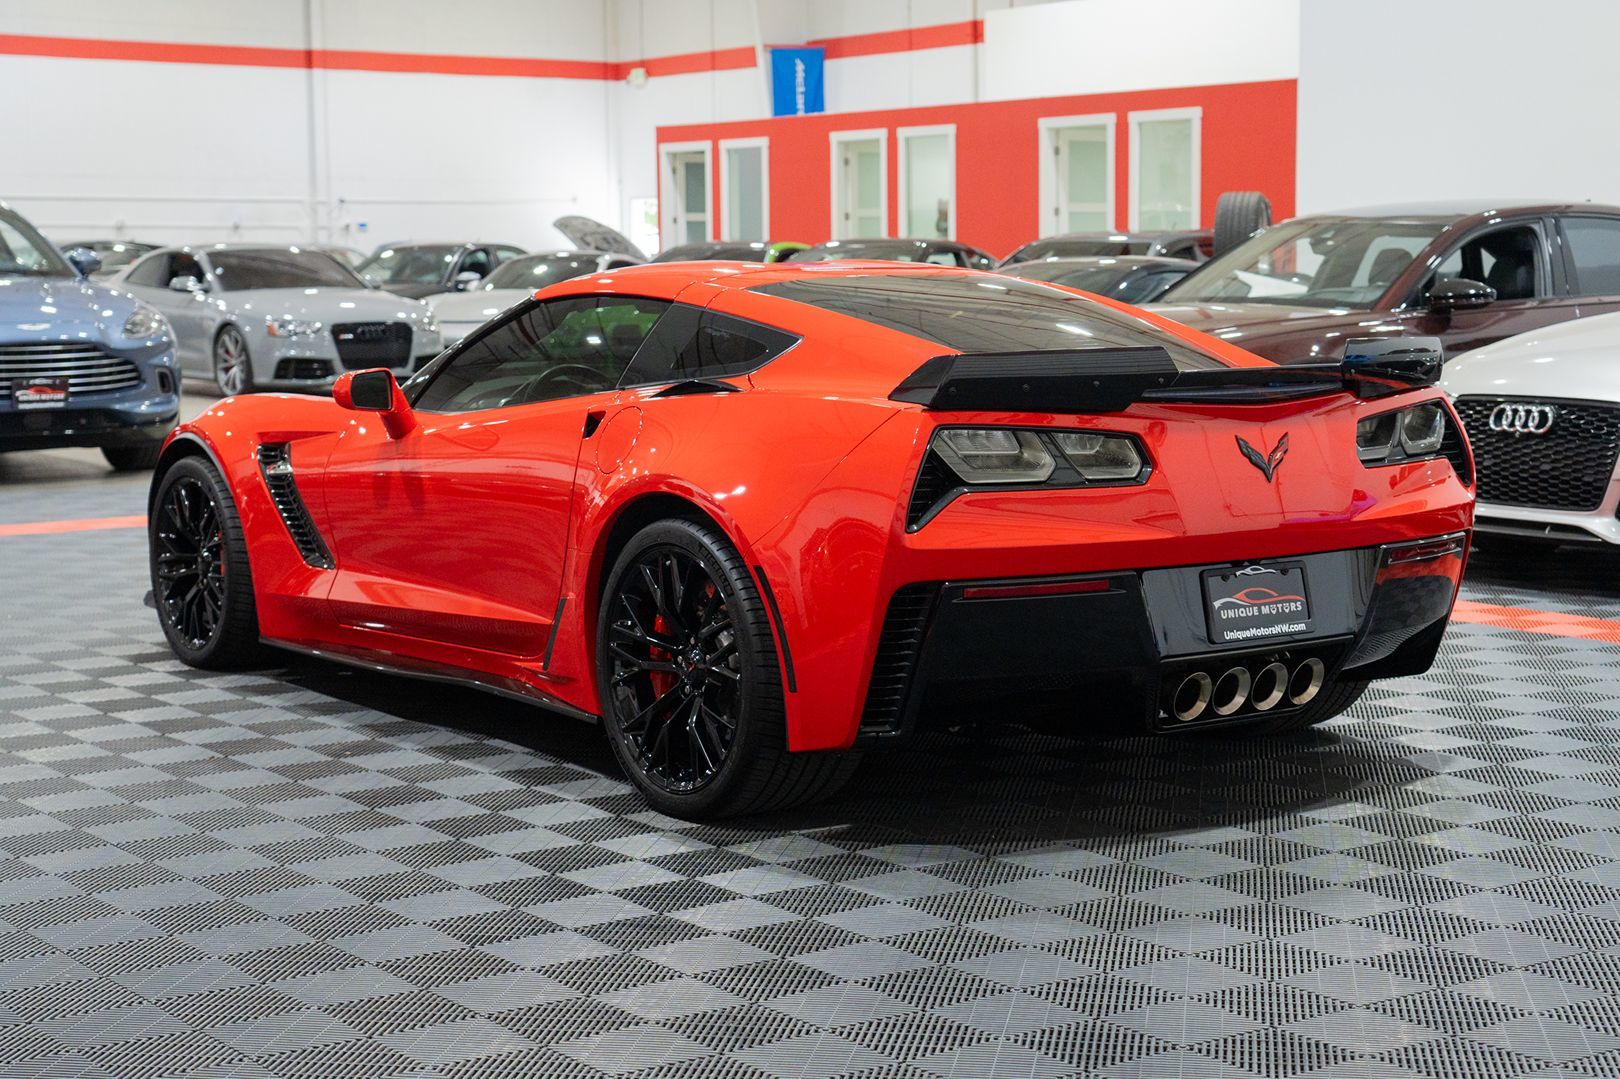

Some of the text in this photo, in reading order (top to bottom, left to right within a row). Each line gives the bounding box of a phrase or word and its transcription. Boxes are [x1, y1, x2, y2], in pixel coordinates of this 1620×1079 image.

[1220, 601, 1302, 619] UNIQUE MOTORS
[1223, 622, 1307, 640] UniqueMotorsNW.com
